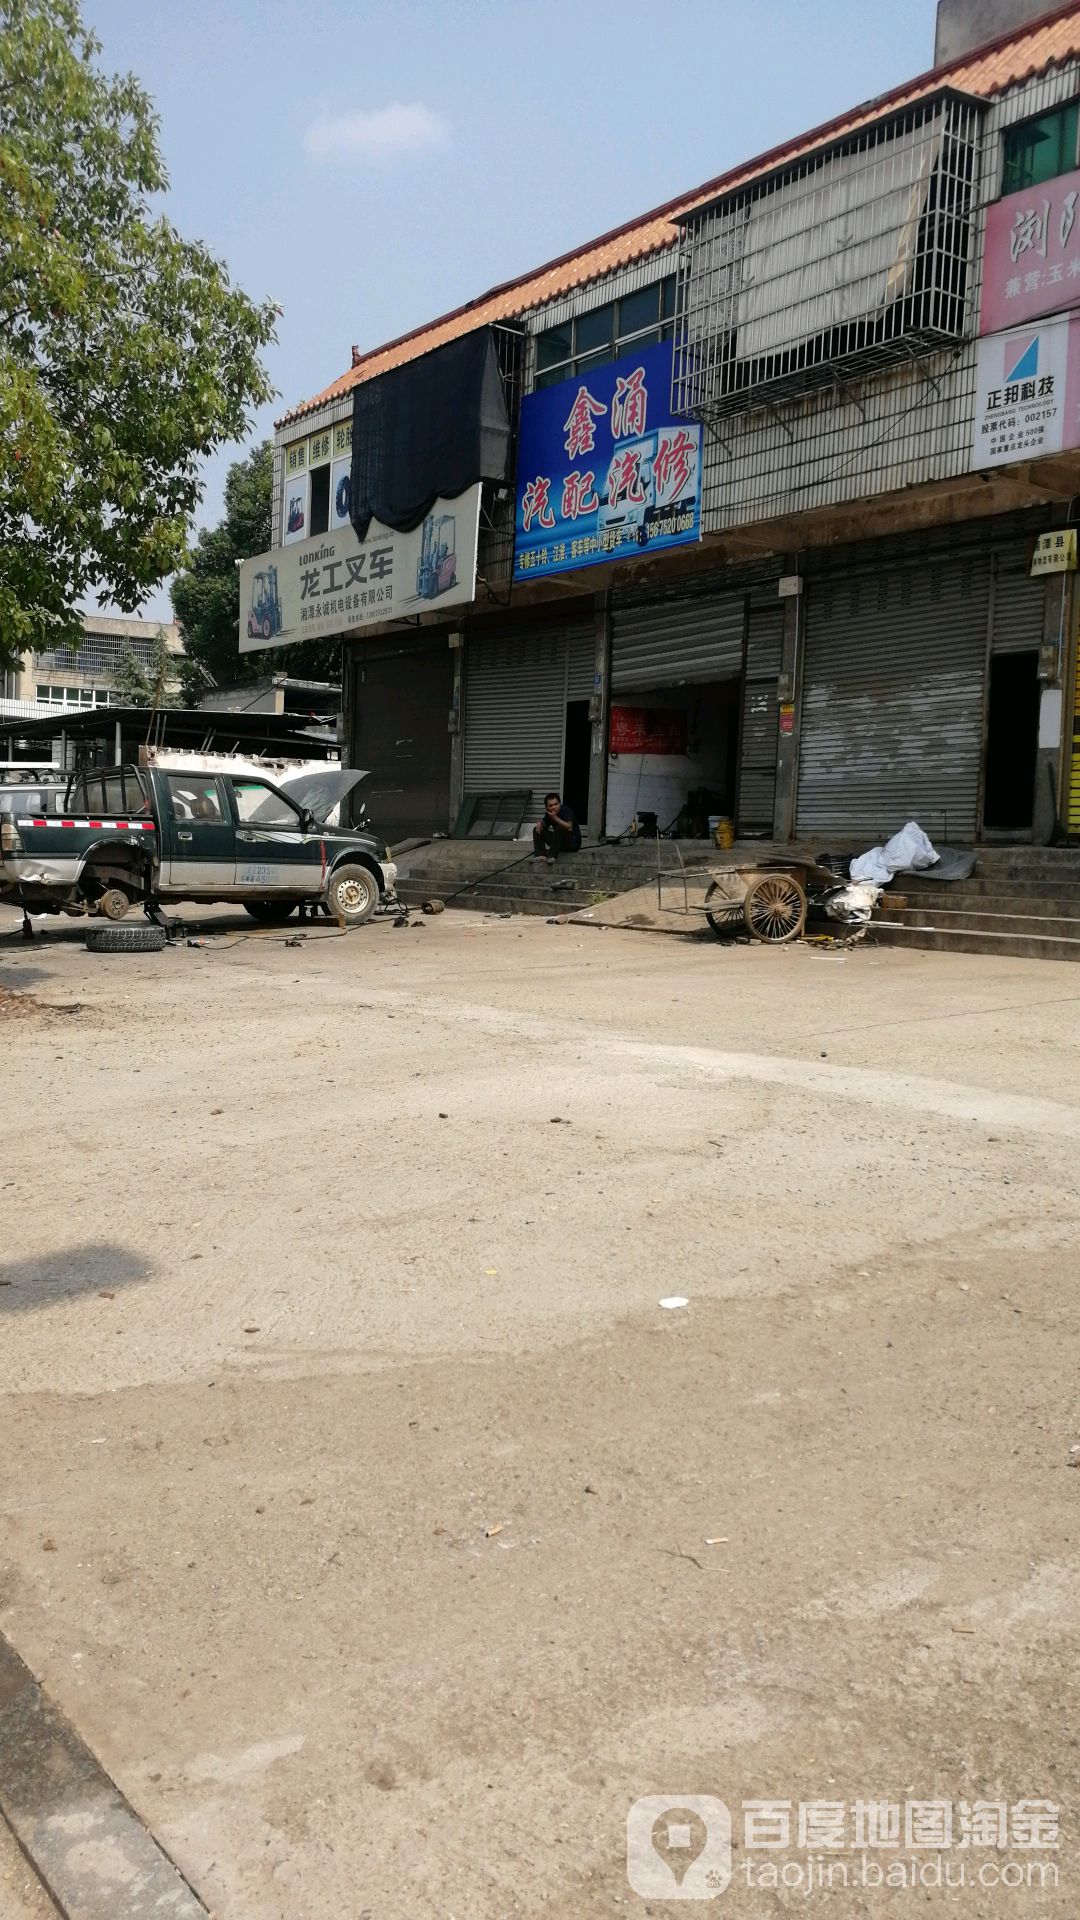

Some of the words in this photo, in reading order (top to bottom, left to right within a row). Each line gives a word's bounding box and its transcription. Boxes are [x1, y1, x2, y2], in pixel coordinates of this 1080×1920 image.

[986, 376, 1055, 410] 正邦科技
[522, 430, 697, 532] 汽配汽修
[300, 546, 394, 600] 龙工叉车
[300, 585, 394, 622] 湘潭永诚机电设备有限公司
